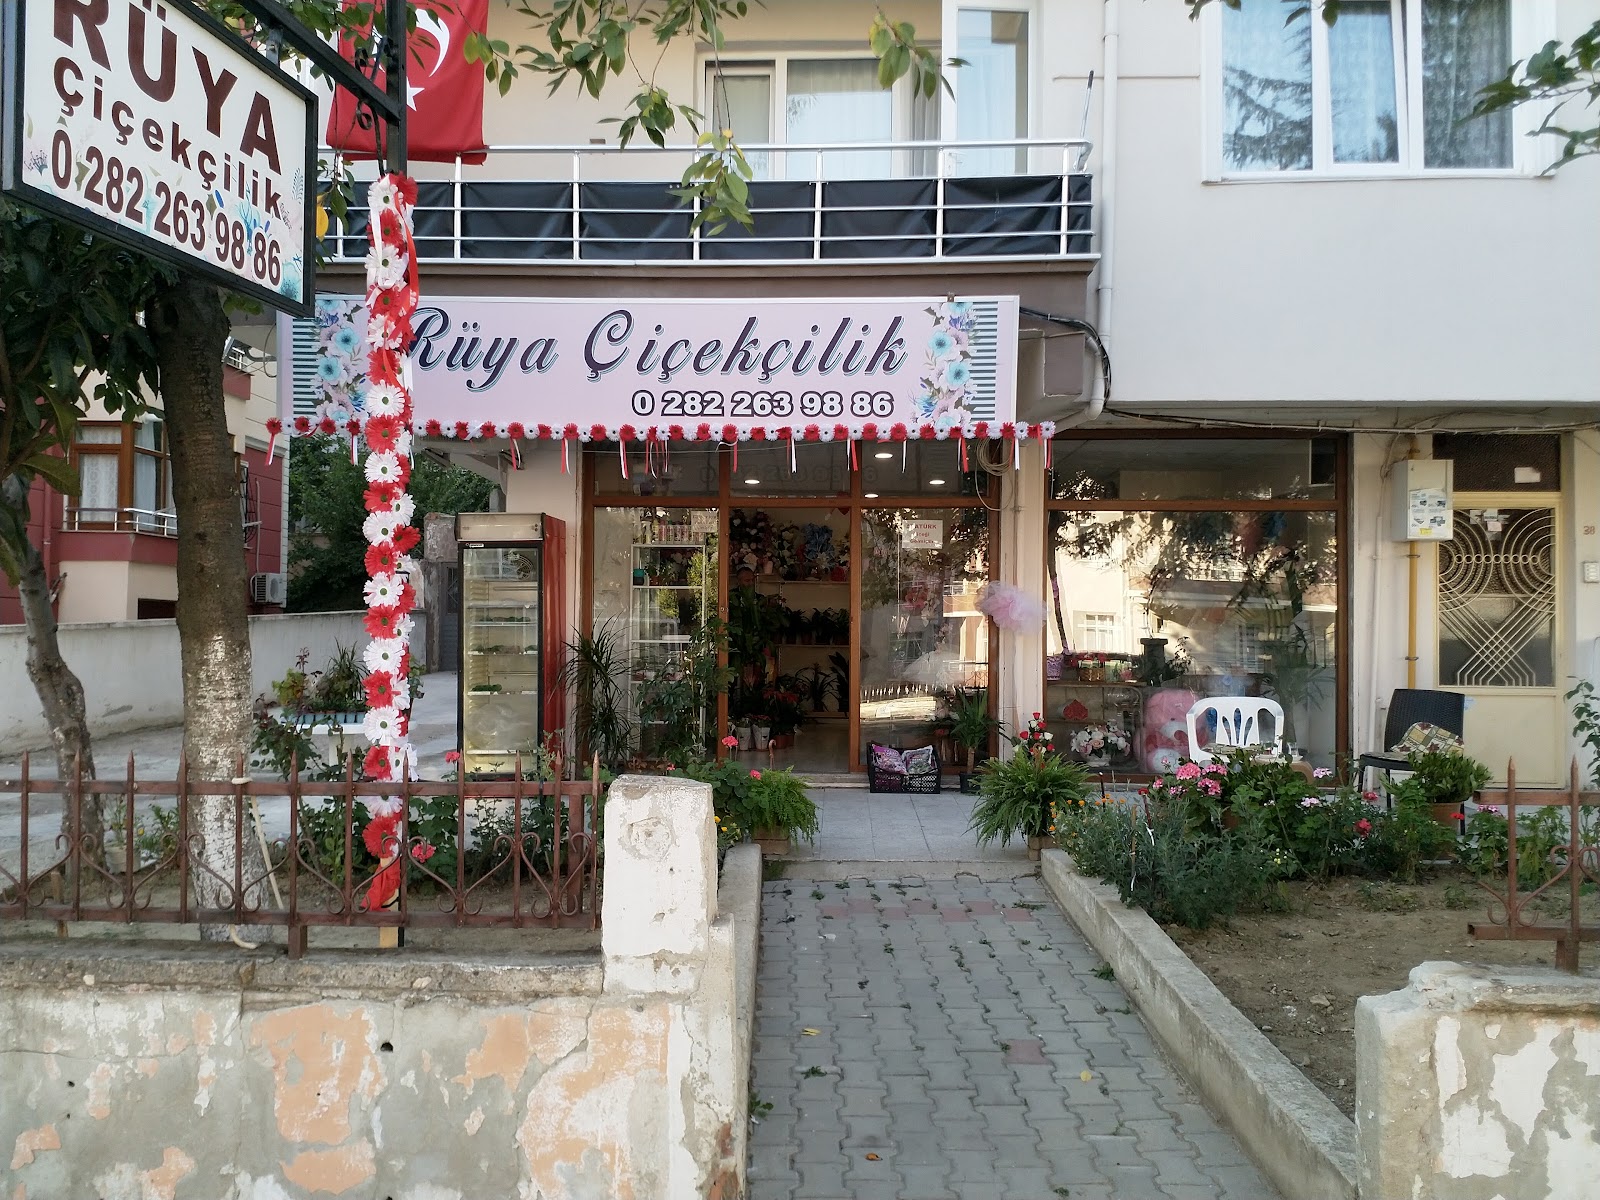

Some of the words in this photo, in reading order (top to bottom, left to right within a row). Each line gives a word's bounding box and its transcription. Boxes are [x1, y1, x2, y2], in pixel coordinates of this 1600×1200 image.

[51, 129, 72, 189] 0
[84, 146, 144, 224] 282
[154, 181, 206, 251] 263
[215, 212, 245, 269] 98
[253, 231, 281, 286] 86
[408, 306, 560, 393] Rüya
[584, 309, 909, 383] Çiçekçilik
[632, 390, 655, 416] 0
[661, 390, 725, 416] 282
[731, 390, 794, 417] 263
[800, 390, 842, 416] 98
[850, 390, 895, 416] 86
